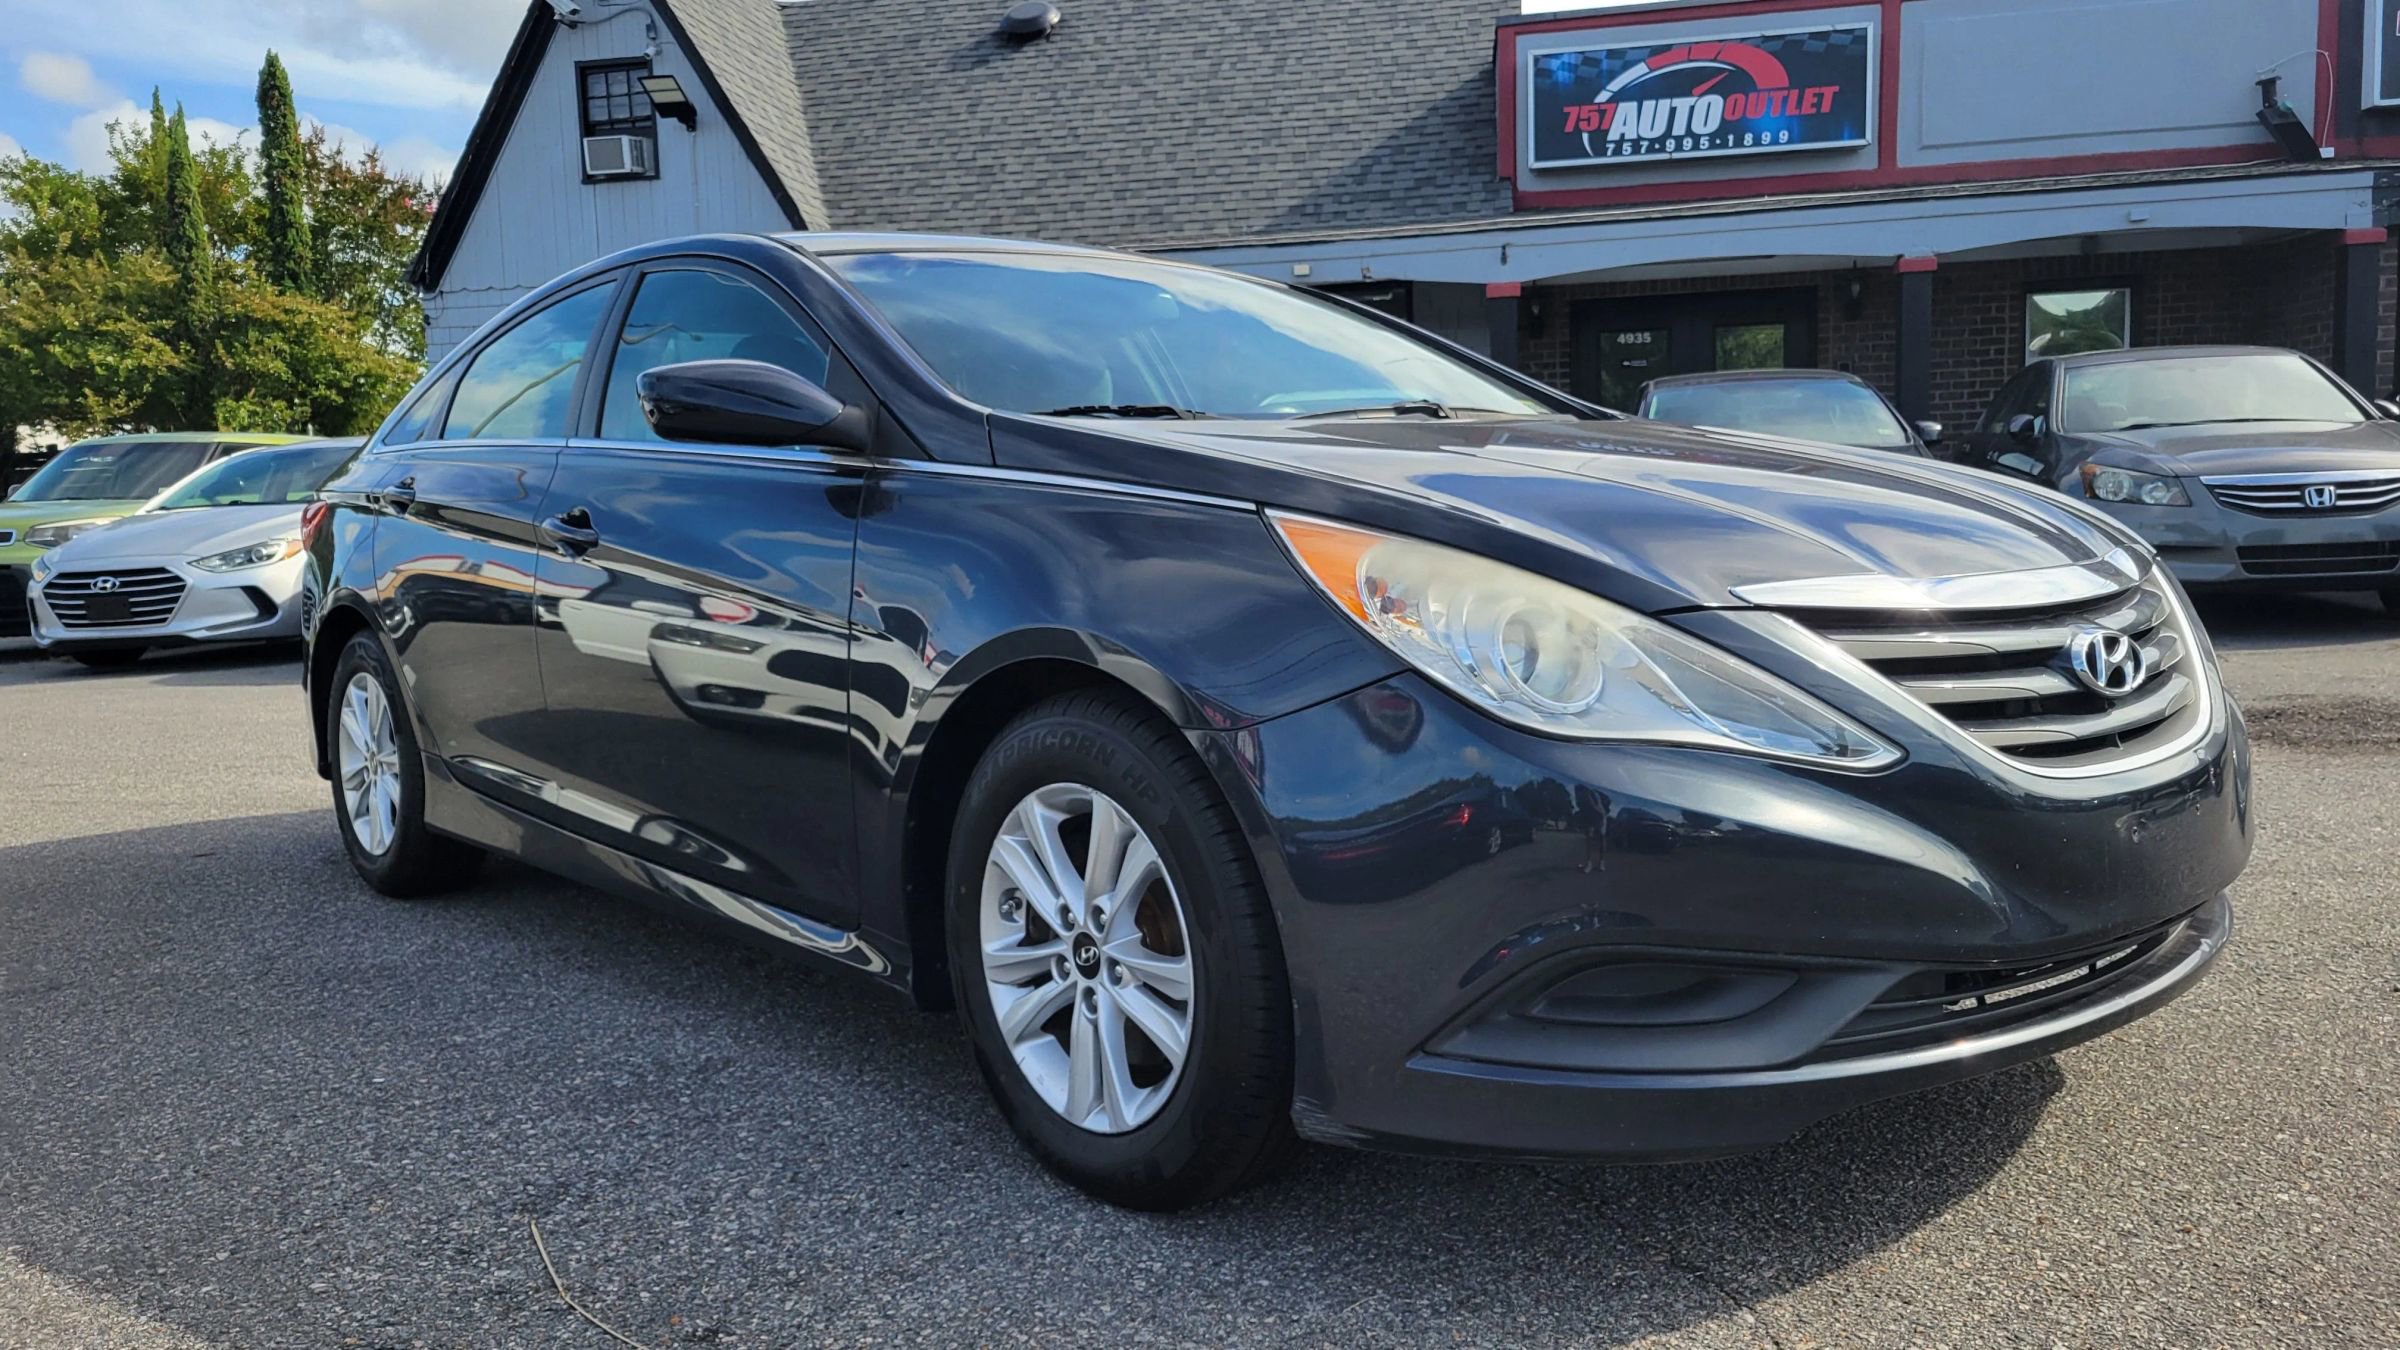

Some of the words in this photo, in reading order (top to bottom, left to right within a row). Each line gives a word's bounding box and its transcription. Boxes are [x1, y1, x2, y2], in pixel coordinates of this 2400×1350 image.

[1607, 94, 1724, 141] AUTO
[1724, 86, 1840, 121] OUTLET
[1616, 332, 1652, 344] 4935
